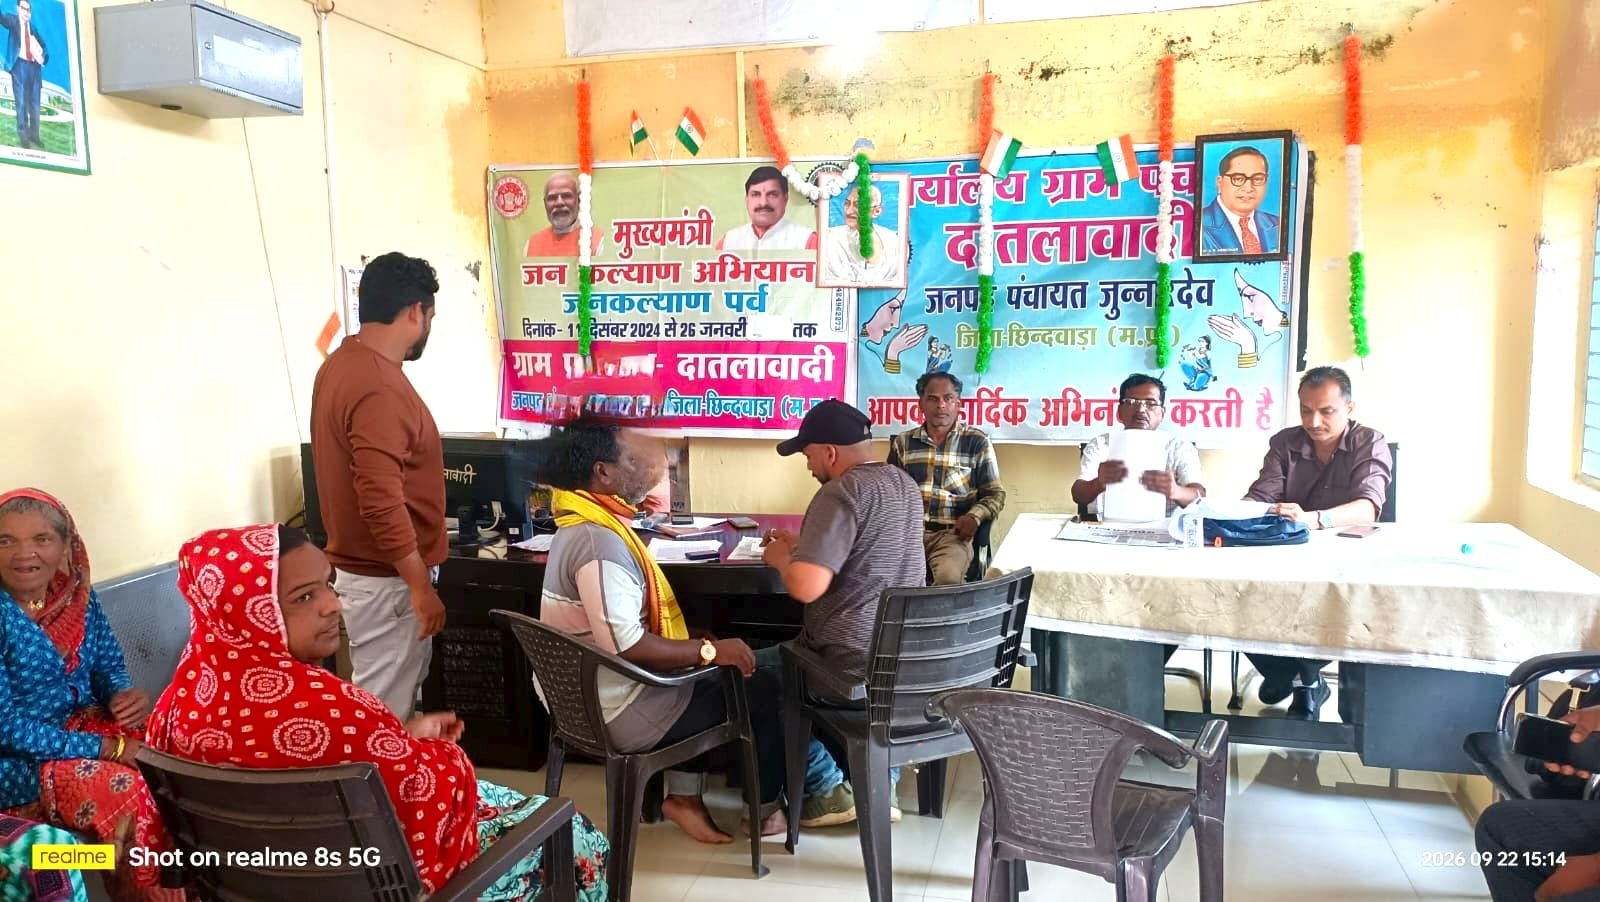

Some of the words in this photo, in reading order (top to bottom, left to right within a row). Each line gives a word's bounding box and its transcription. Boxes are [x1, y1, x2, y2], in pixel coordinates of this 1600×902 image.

[909, 163, 1028, 206] ार्यालय
[613, 208, 714, 259] मुख्यमंत्री
[944, 198, 1195, 270] दतलावादी
[521, 265, 567, 286] जन
[694, 253, 816, 283] अभियान
[724, 284, 769, 313] पर्व
[1007, 274, 1088, 310] पंचायत
[630, 322, 660, 338] 2024
[664, 317, 677, 338] से
[680, 322, 696, 338] 26
[699, 317, 747, 338] जनवरी
[792, 322, 818, 338] तक
[511, 352, 552, 378] ग्राम
[676, 344, 835, 382] दातलावादी
[1170, 387, 1244, 428] करती
[1255, 386, 1275, 431] है
